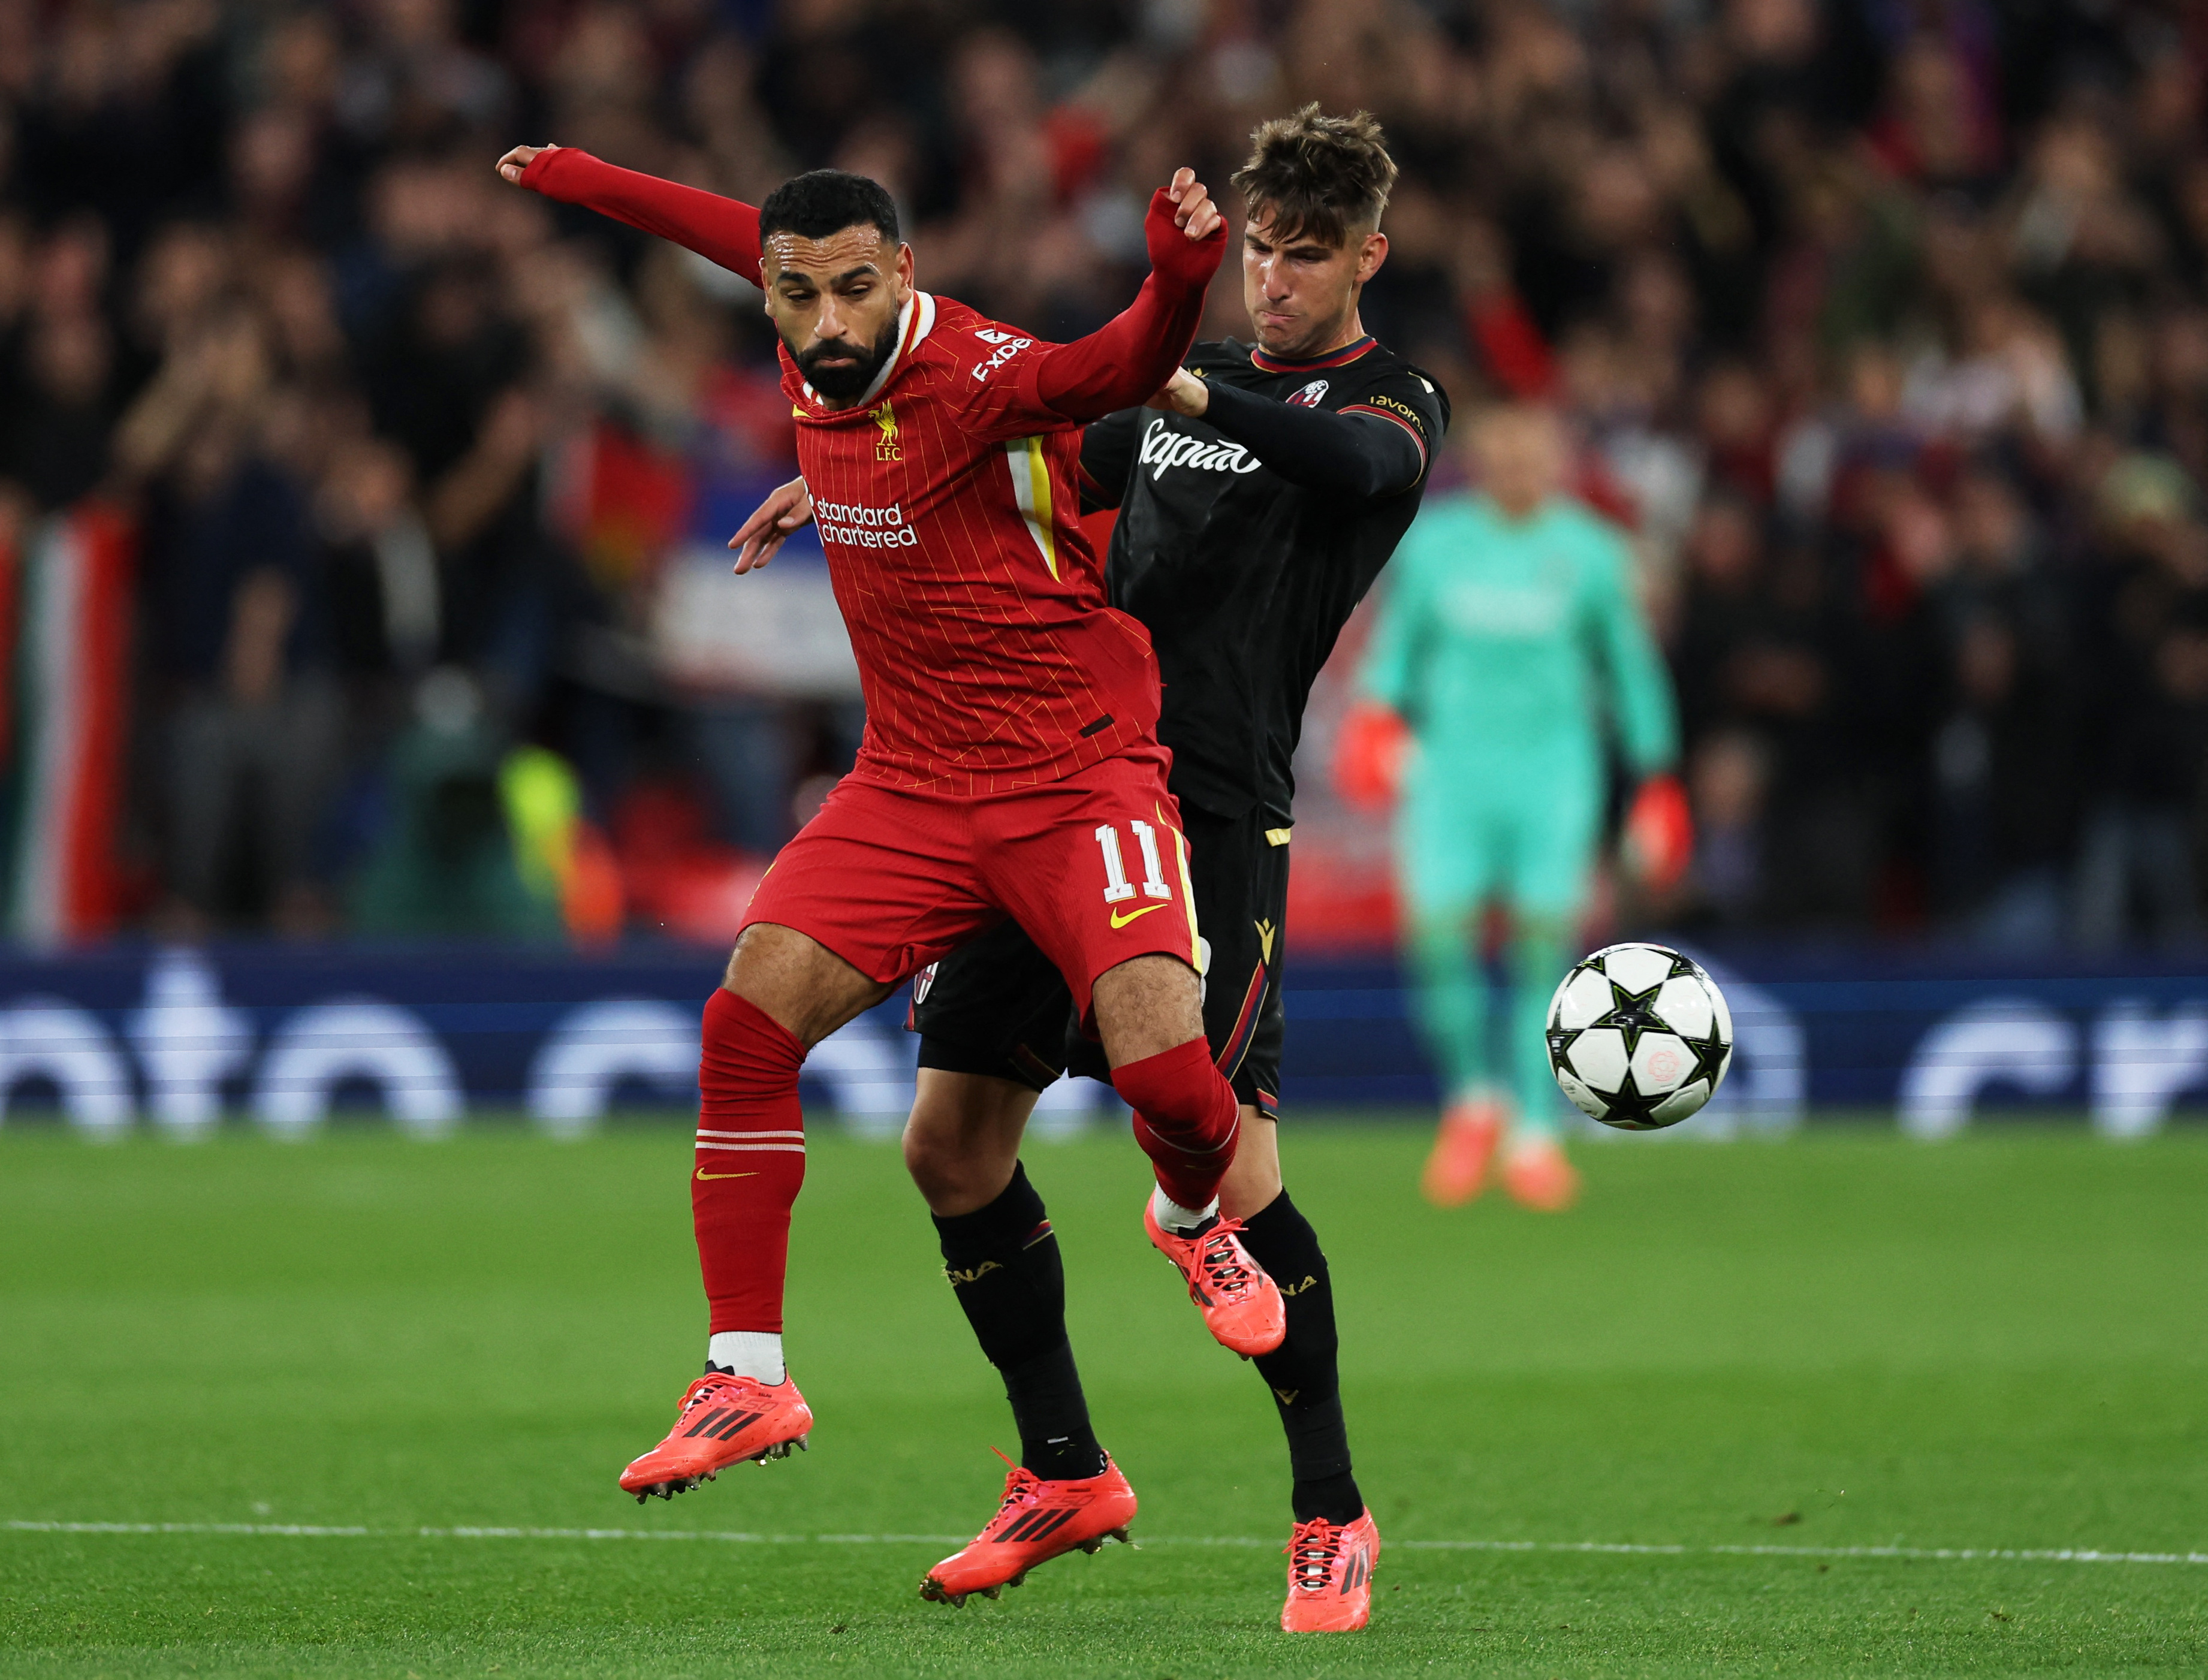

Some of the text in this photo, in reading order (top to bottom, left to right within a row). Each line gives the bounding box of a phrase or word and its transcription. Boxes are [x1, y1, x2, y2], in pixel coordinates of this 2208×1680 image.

[818, 497, 902, 526] standard
[822, 521, 918, 548] chartered
[1095, 820, 1172, 904] 11
